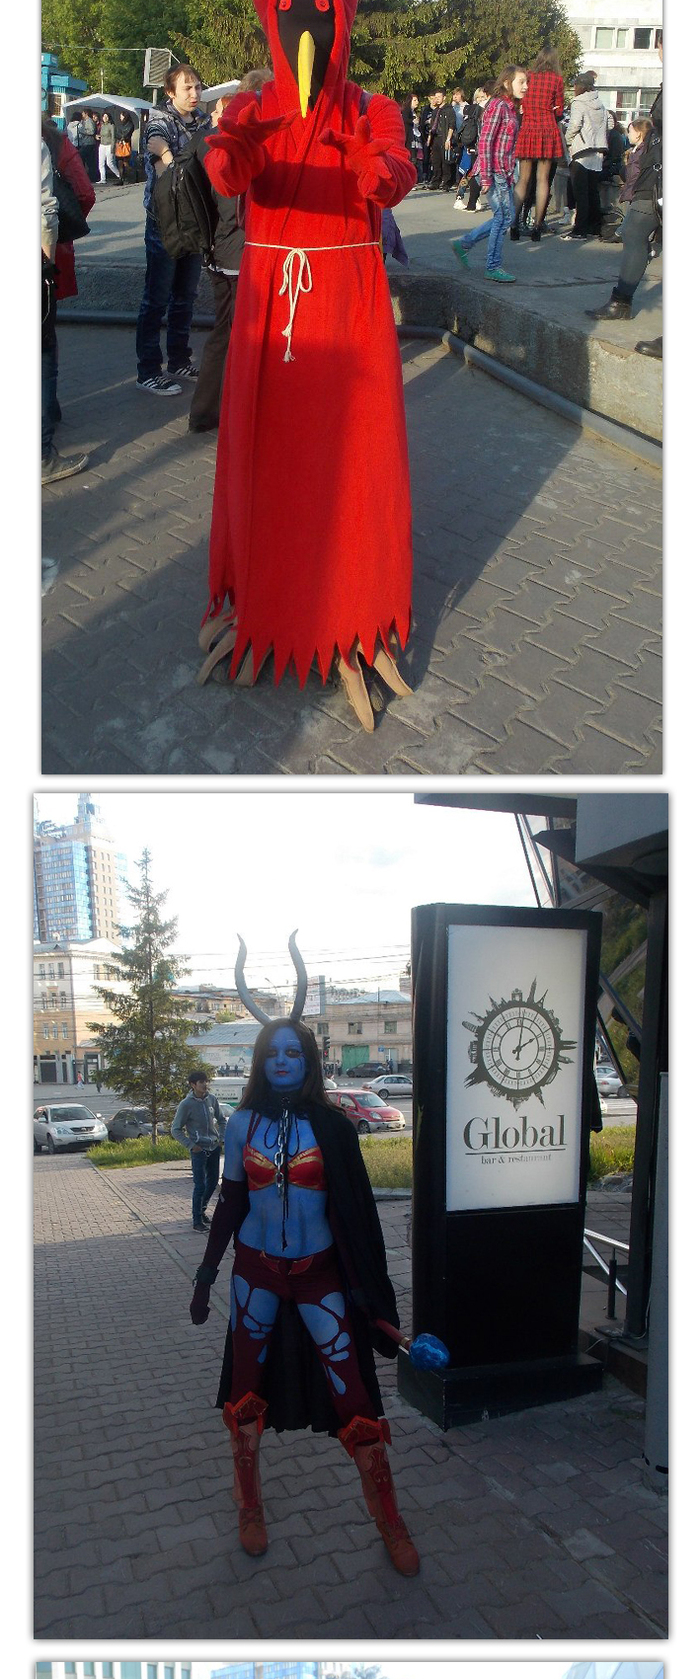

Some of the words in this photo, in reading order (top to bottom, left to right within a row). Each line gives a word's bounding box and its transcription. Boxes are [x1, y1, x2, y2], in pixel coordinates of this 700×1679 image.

[463, 1115, 567, 1150] Global
[481, 1156, 497, 1164] bar
[508, 1154, 552, 1164] restaurant
